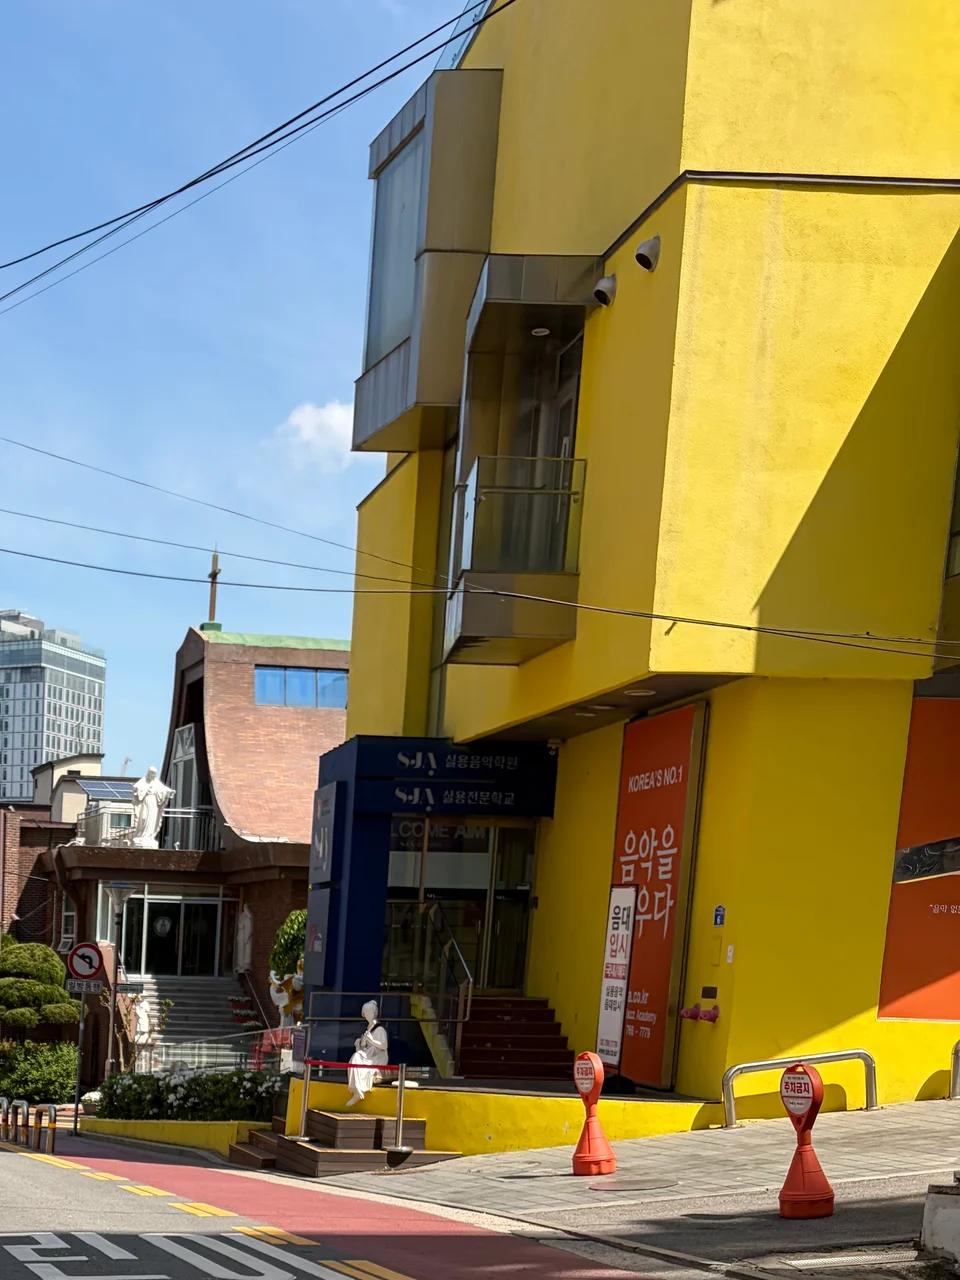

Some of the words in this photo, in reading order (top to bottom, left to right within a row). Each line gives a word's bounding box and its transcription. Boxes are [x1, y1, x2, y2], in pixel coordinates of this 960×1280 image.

[628, 769, 663, 793] KOREA'S
[620, 824, 678, 885] 음악을
[636, 883, 674, 940] 우다
